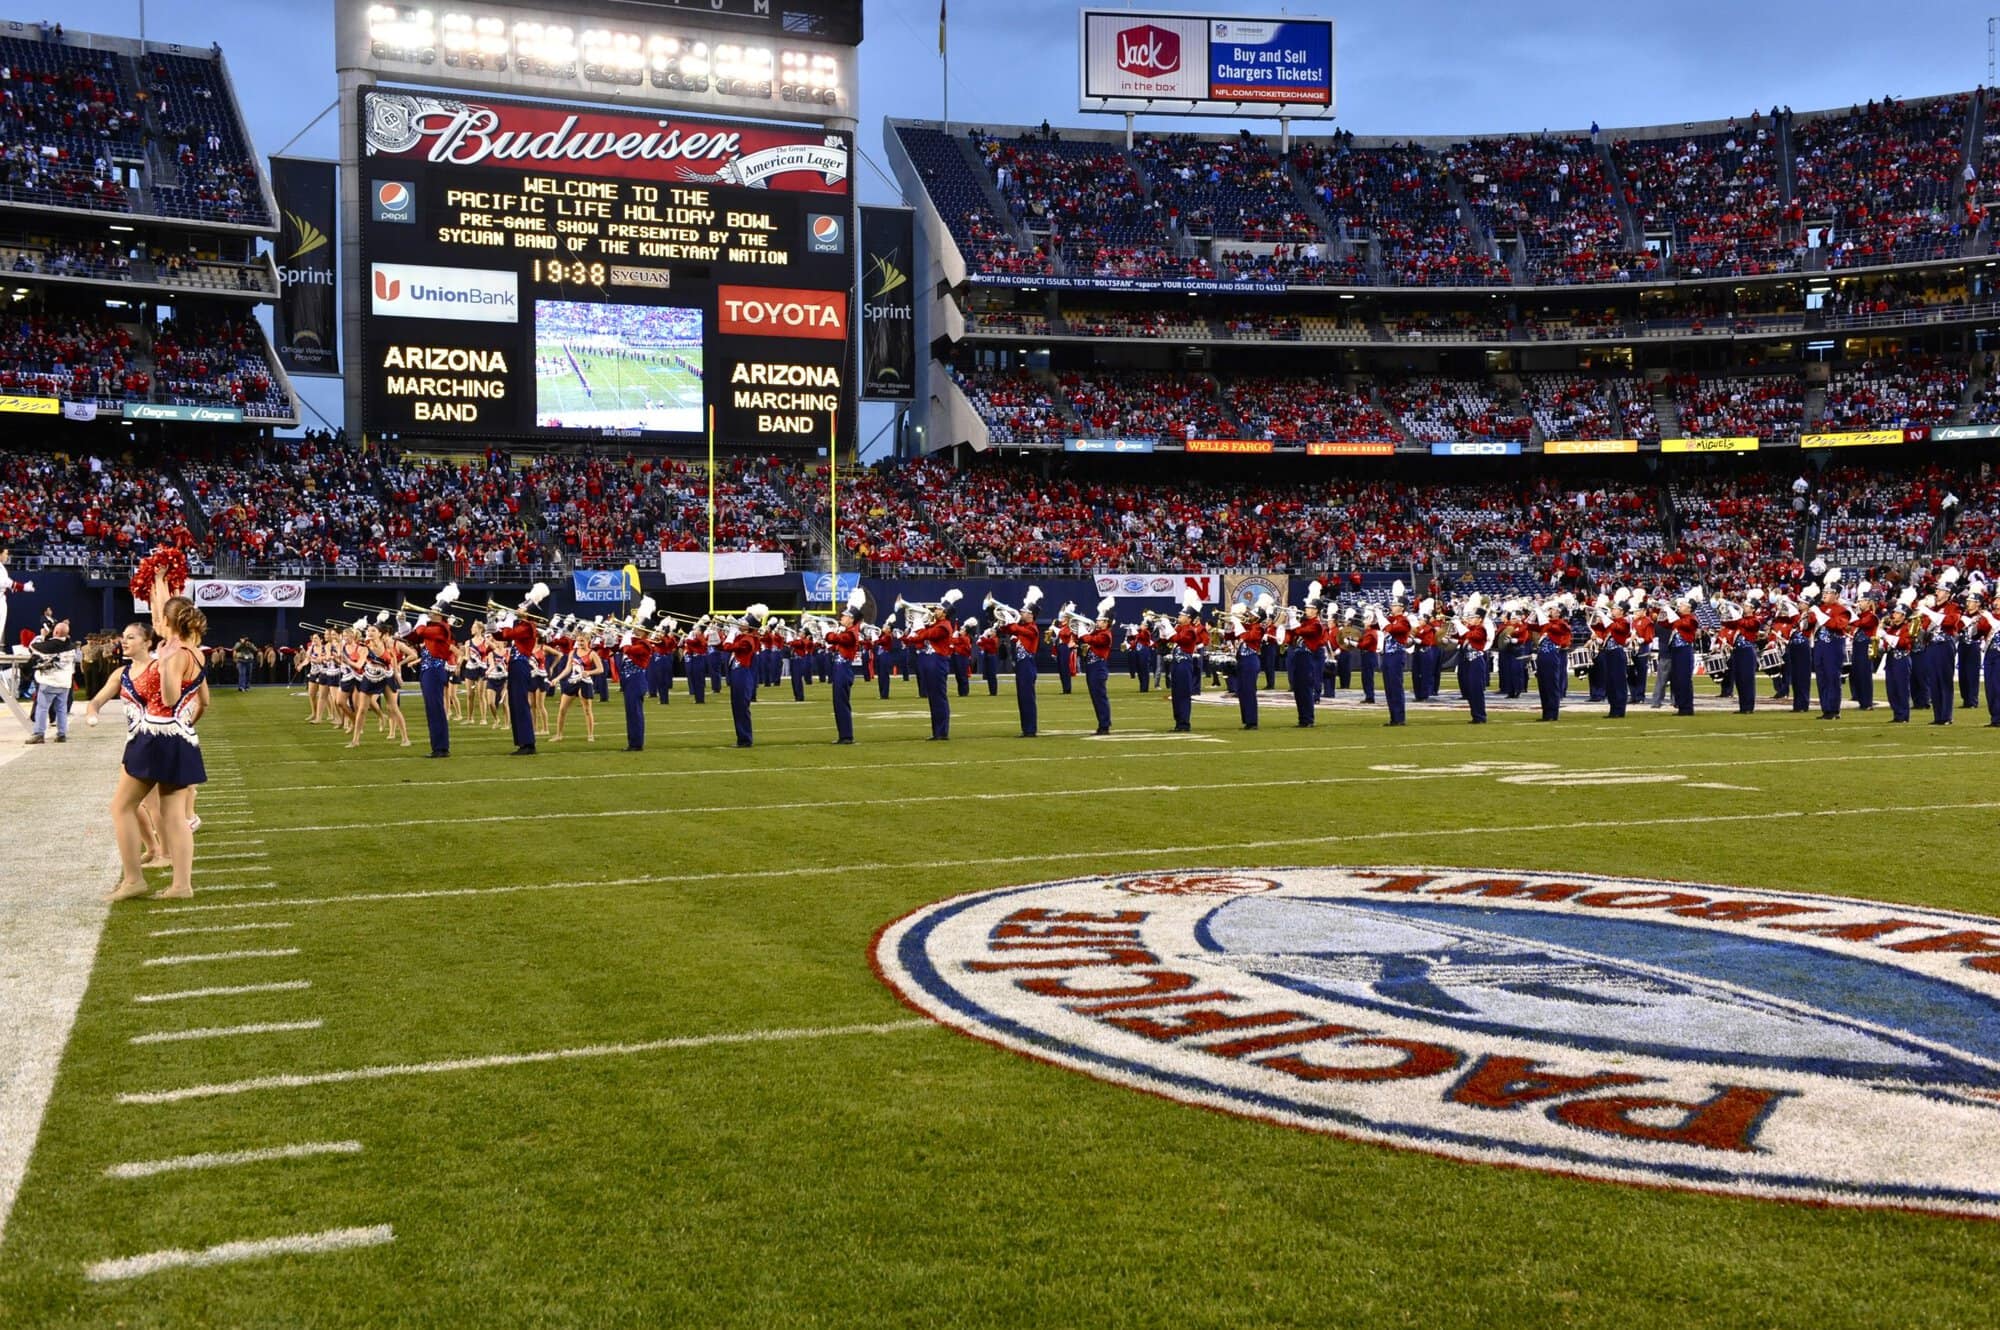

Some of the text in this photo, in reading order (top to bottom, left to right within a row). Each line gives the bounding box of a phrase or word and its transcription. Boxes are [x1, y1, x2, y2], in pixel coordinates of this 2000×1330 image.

[1118, 30, 1178, 70] Jack
[1233, 48, 1307, 65] Buy and Sell
[1218, 65, 1323, 82] Chargers Tickets!
[1121, 81, 1176, 92] in the box
[1215, 89, 1325, 99] NFL.COM/TICKETEXCHANGE
[411, 109, 741, 165] Budweiser
[744, 152, 845, 178] American Lager
[524, 177, 710, 207] WELCOME TO THE
[380, 212, 408, 221] pepsi
[447, 190, 778, 231] PACIFIC LIFE HOLIDAY BOWL
[460, 212, 769, 247] PRE-GAME SHOW PRESENTED BY THE
[438, 227, 505, 246] SYCUAN
[514, 233, 558, 249] BAND
[567, 237, 588, 251] OF
[598, 239, 630, 255] THE
[729, 248, 788, 265] NATION
[815, 243, 837, 251] pepsi
[277, 265, 334, 287] Sprint
[532, 258, 606, 286] 19:38
[612, 270, 670, 284] SYCUAN
[1012, 276, 1045, 285] CONDUCT
[1046, 278, 1072, 287] ISSUES,
[1162, 281, 1182, 289] YOUR
[1182, 282, 1218, 290] LOCATION
[410, 284, 516, 306] UnionBank
[725, 300, 841, 328] TOYOTA
[863, 303, 912, 322] Sprint
[383, 346, 509, 373] ARIZONA
[730, 363, 841, 388] ARIZONA
[387, 376, 505, 399] MARCHING
[414, 402, 478, 422] BAND
[734, 391, 838, 412] MARCHING
[758, 415, 814, 434] BAND
[1188, 441, 1271, 452] WELLS FARGO
[1451, 443, 1507, 455] GEICO
[576, 590, 613, 601] PACIFIC
[1184, 577, 1210, 601] N
[961, 907, 1161, 973] LIFE
[1012, 970, 1804, 1153] PACIFIC
